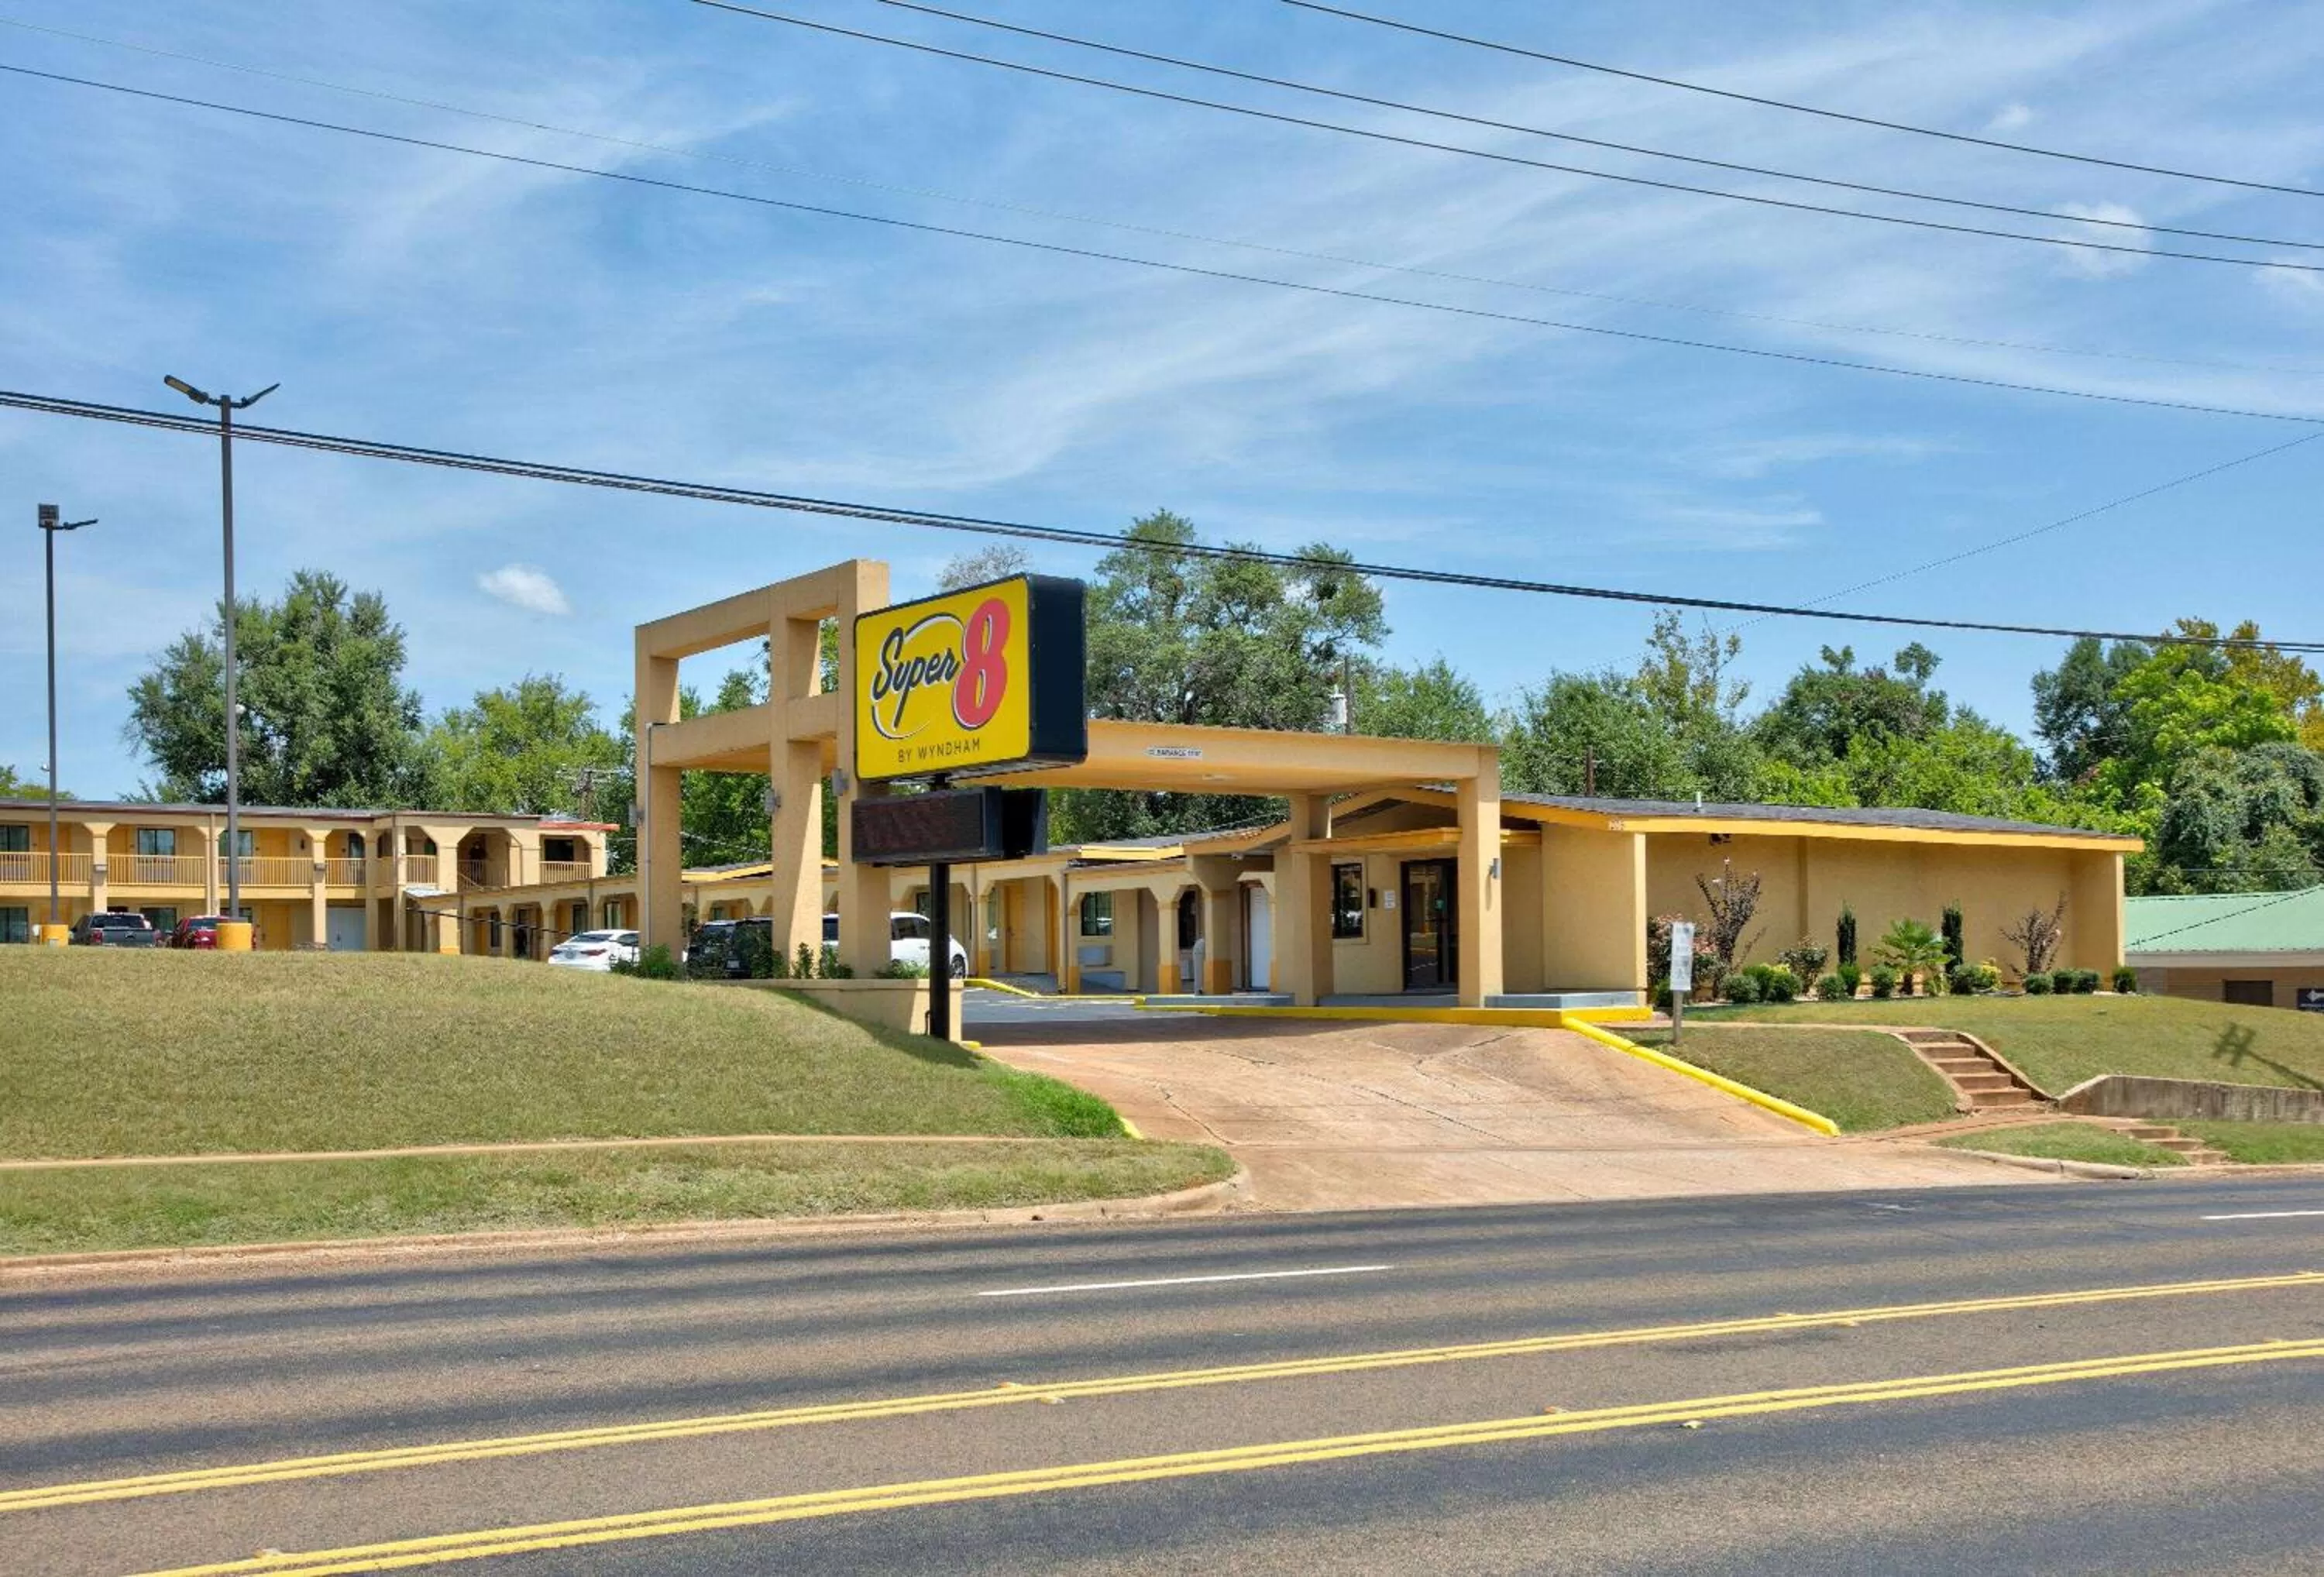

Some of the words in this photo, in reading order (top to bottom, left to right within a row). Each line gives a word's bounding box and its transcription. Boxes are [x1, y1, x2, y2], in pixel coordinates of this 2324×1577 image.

[871, 627, 960, 730] Super
[952, 597, 1011, 730] 8
[898, 749, 913, 763] BY
[918, 738, 982, 760] WYNDHAM
